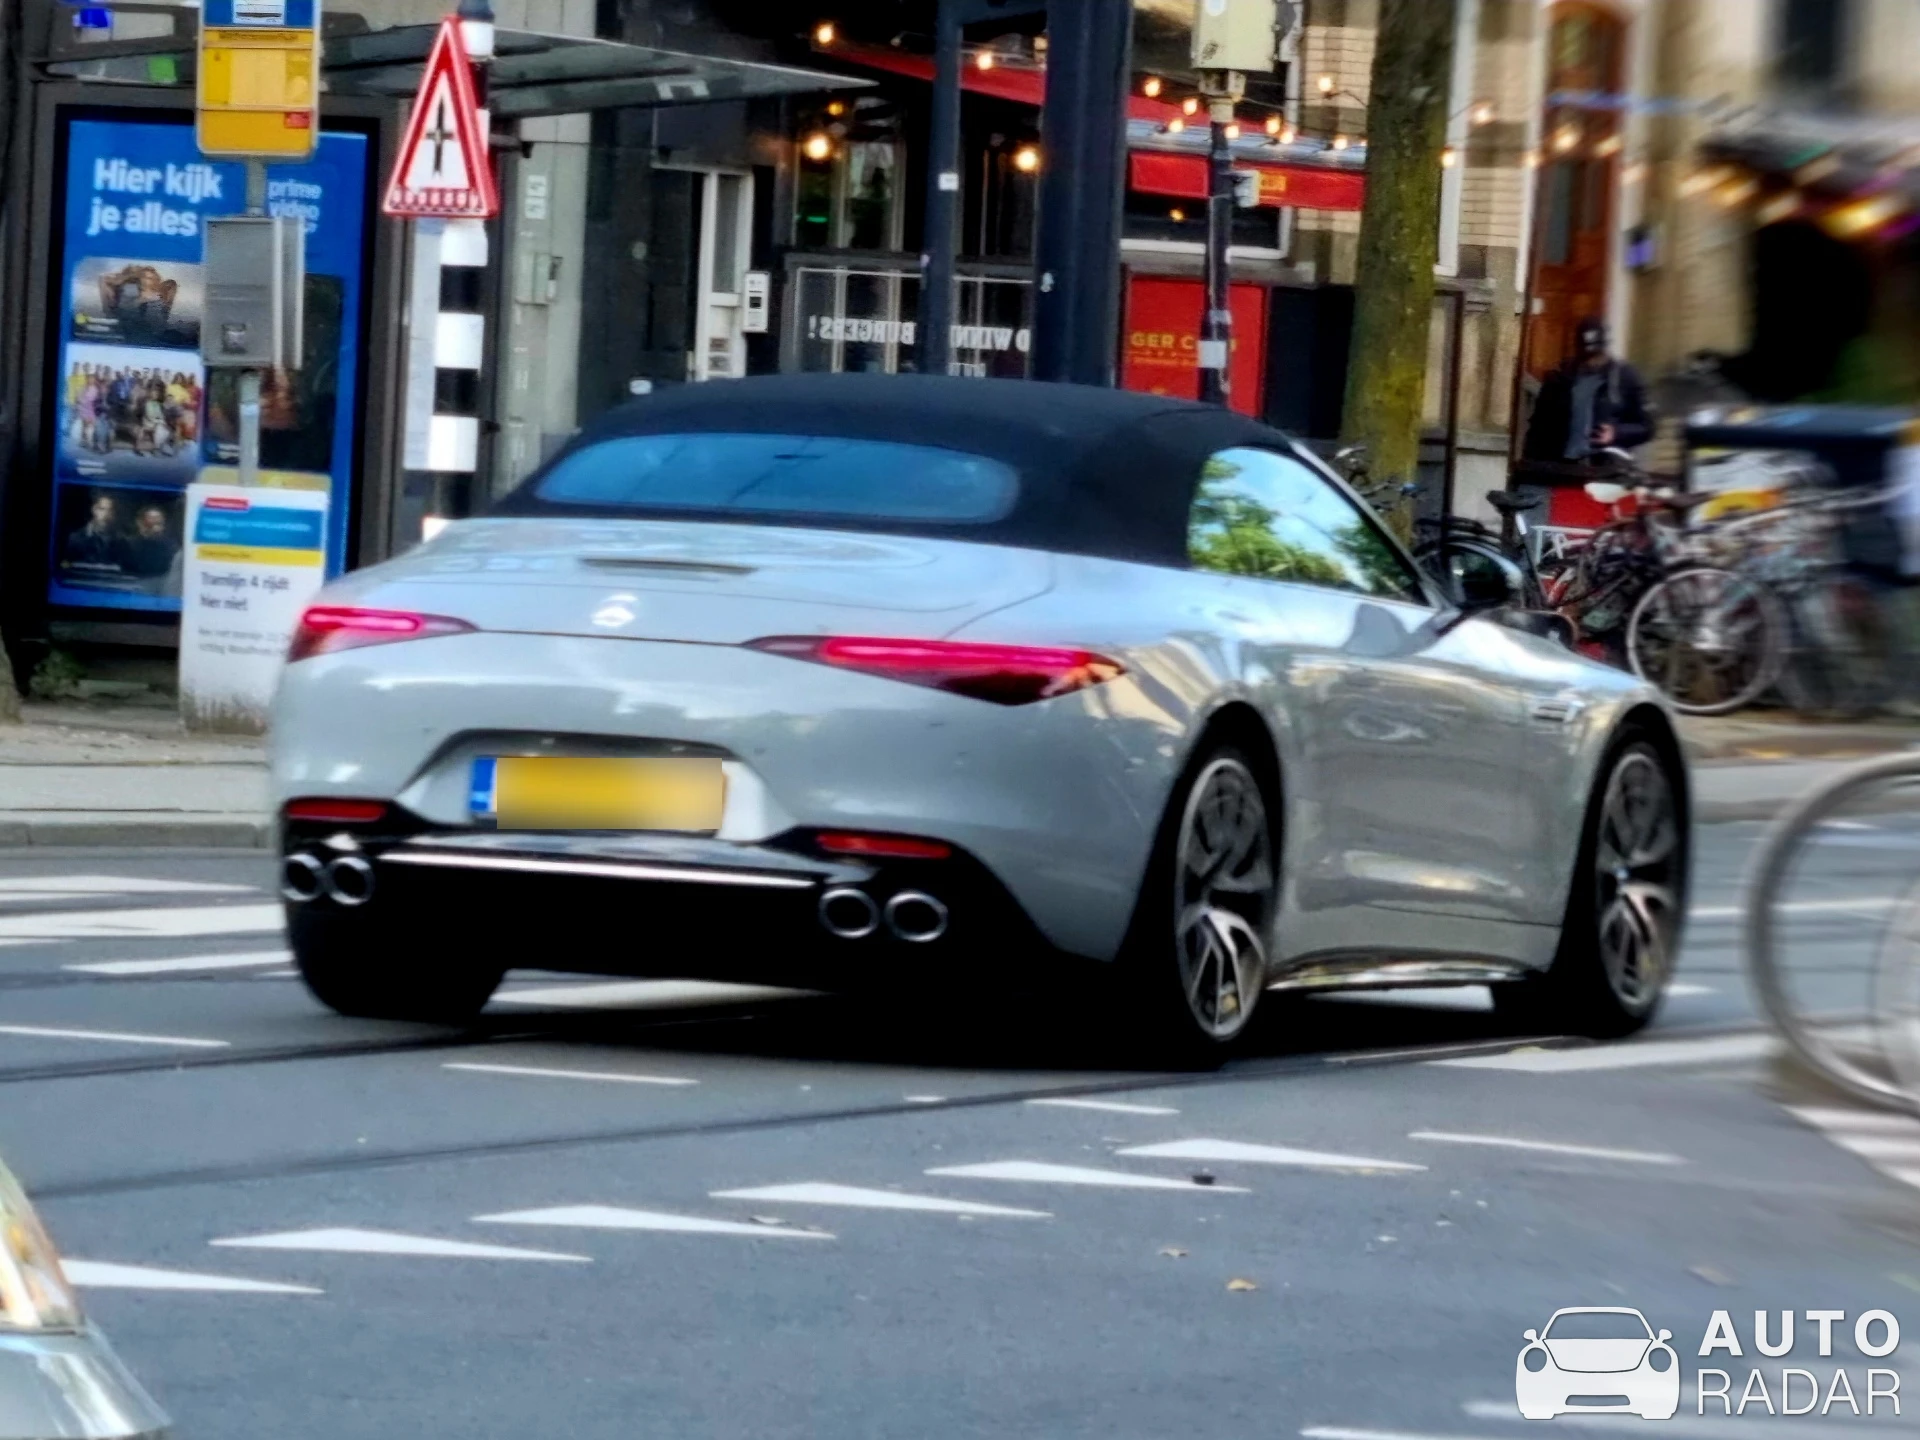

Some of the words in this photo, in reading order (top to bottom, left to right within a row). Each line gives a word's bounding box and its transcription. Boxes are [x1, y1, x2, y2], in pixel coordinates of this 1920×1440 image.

[94, 158, 162, 194] Hier
[164, 162, 223, 204] kijk
[267, 178, 322, 201] prime
[86, 196, 121, 237] je
[123, 201, 198, 237] alles
